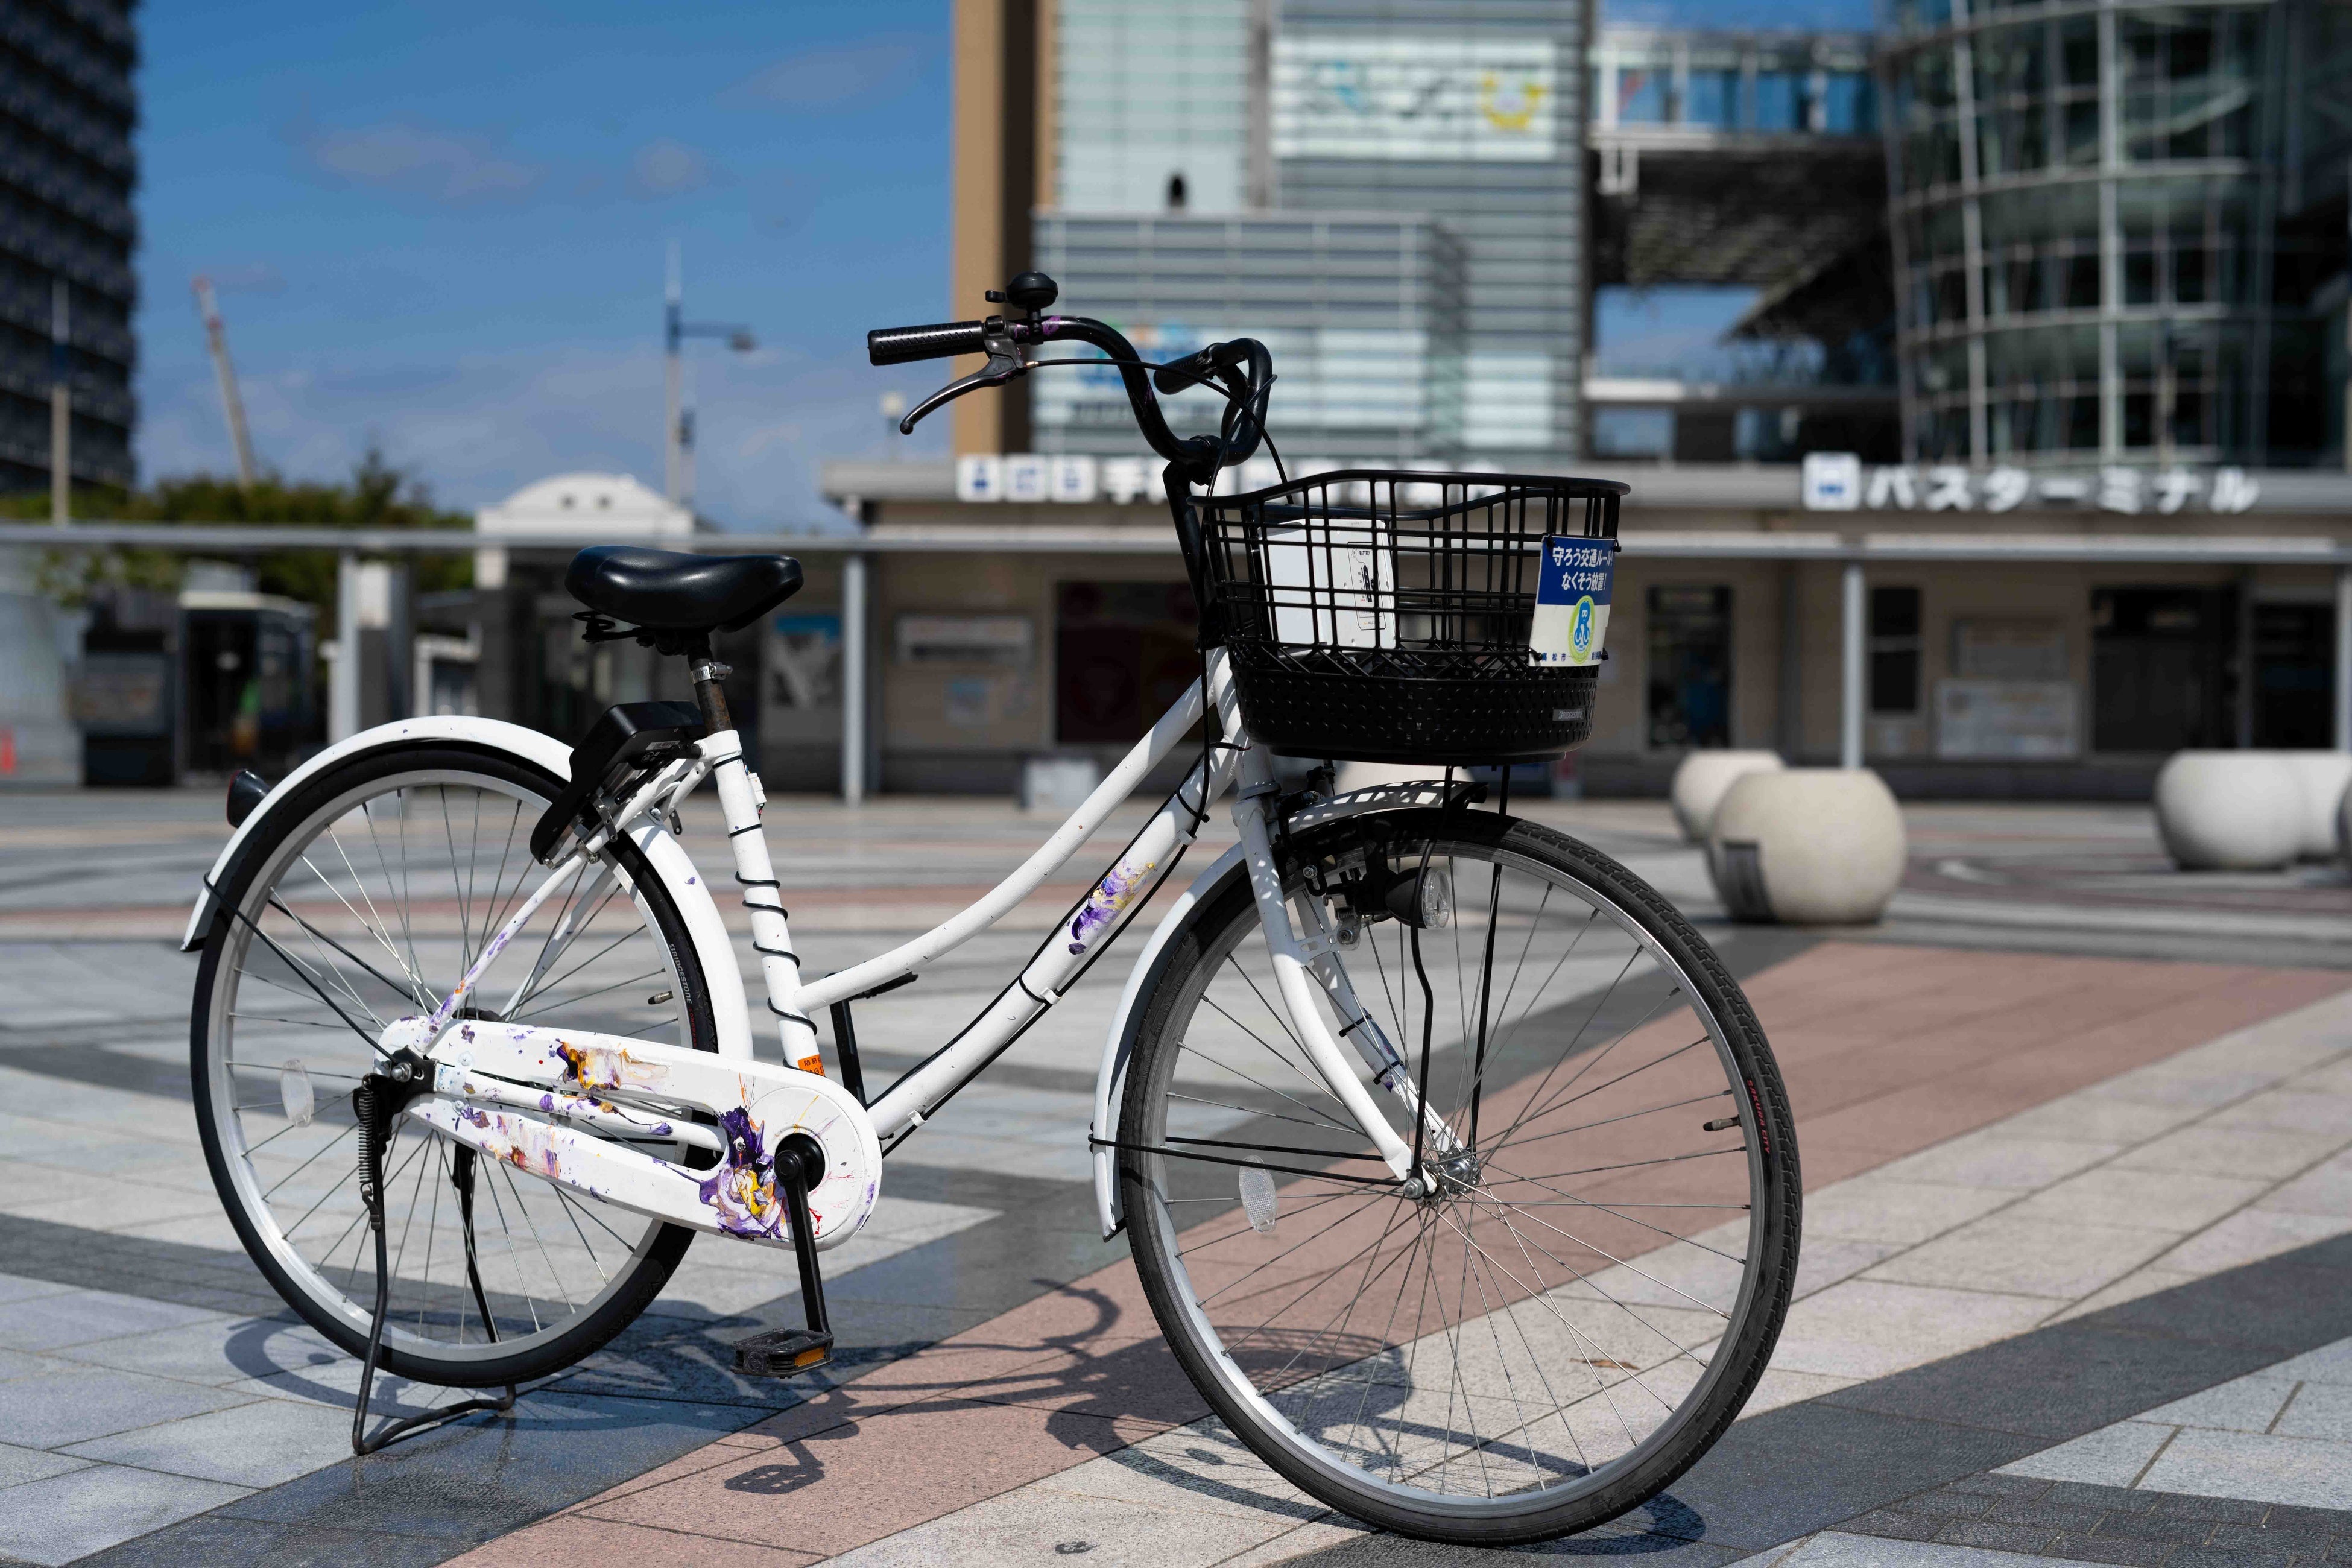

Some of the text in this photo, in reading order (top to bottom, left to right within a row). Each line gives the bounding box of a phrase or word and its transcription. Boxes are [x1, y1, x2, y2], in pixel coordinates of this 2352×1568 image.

[1865, 465, 2261, 514] バスターミナル
[669, 943, 692, 1004] BRIDGESTONE
[1747, 1079, 1770, 1154] SAKURA CITY
